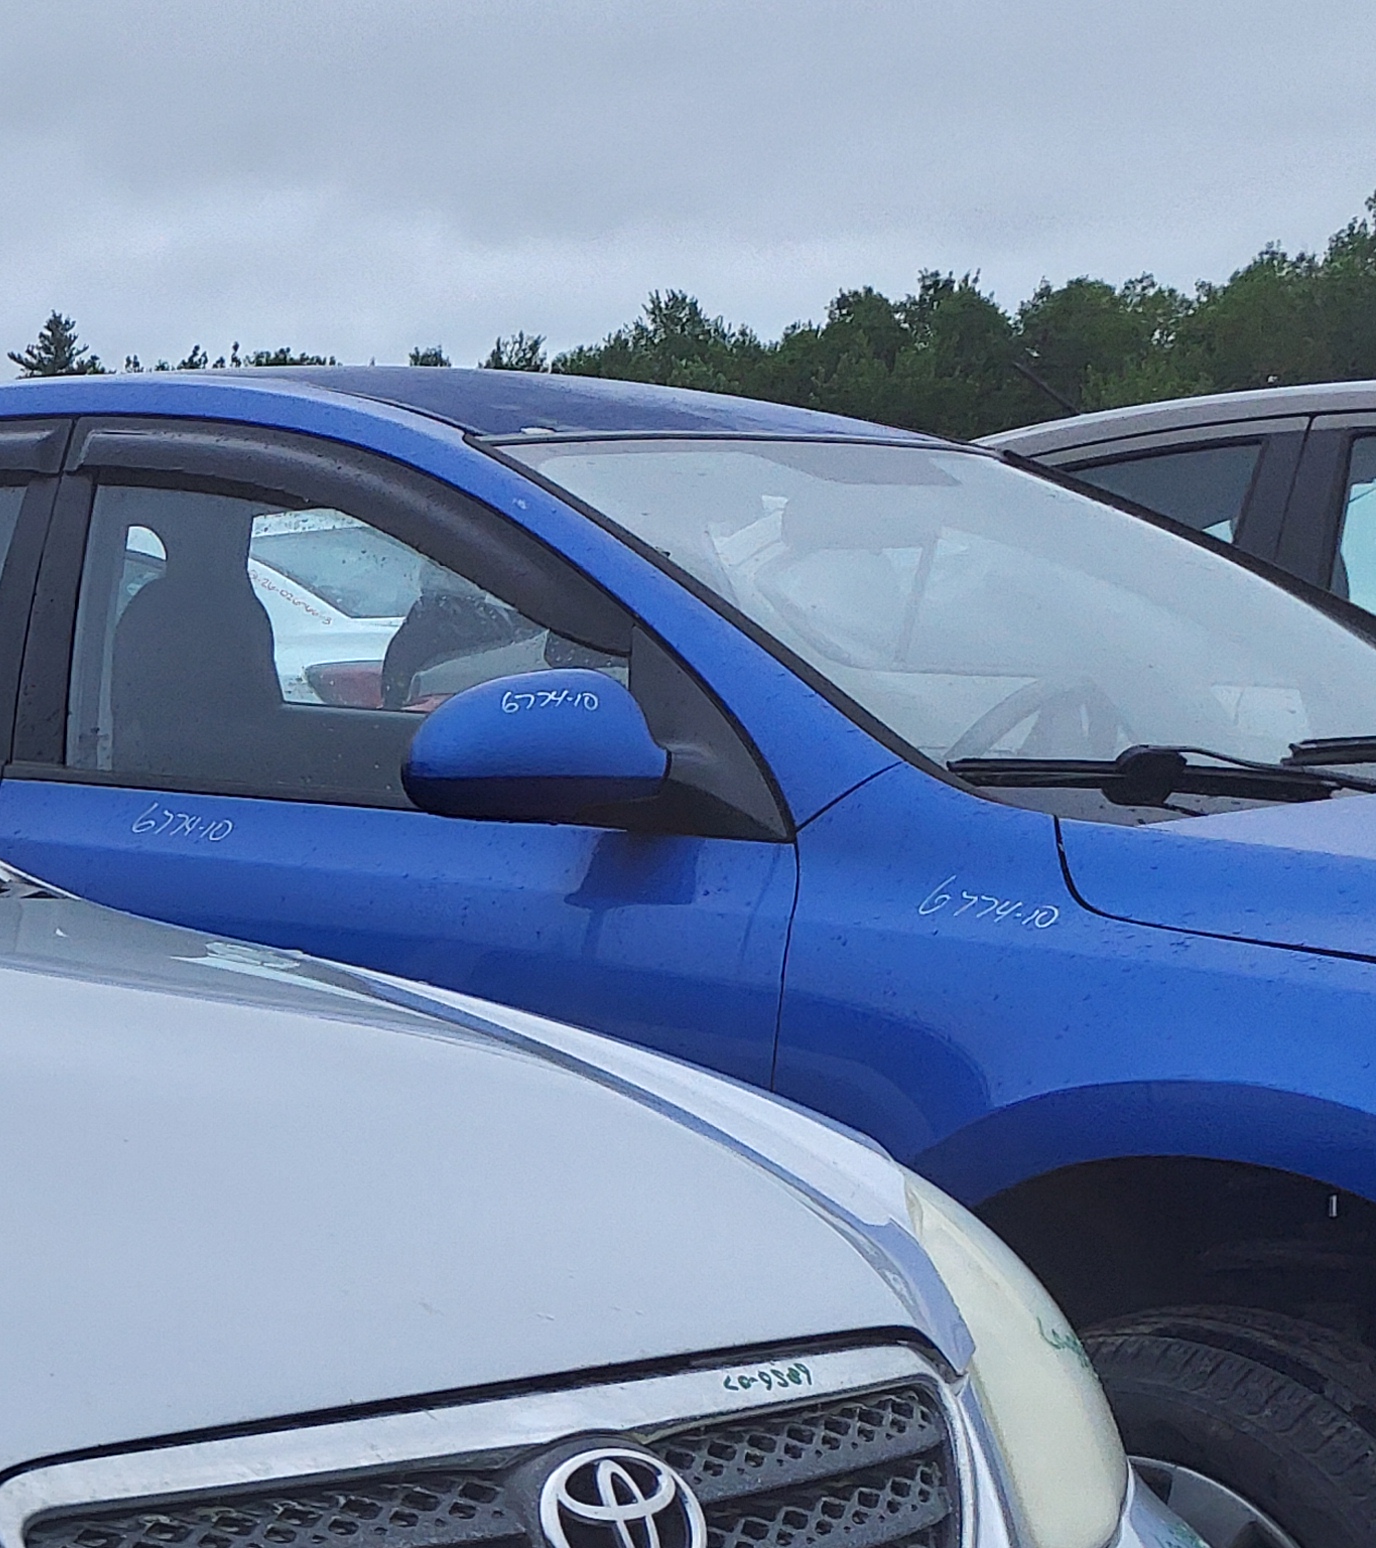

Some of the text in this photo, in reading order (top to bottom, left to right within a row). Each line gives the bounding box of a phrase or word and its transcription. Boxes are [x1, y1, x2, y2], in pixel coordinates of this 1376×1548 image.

[501, 689, 599, 714] 6774-10
[132, 802, 234, 841] 6774-10
[918, 874, 1059, 929] 6774-10
